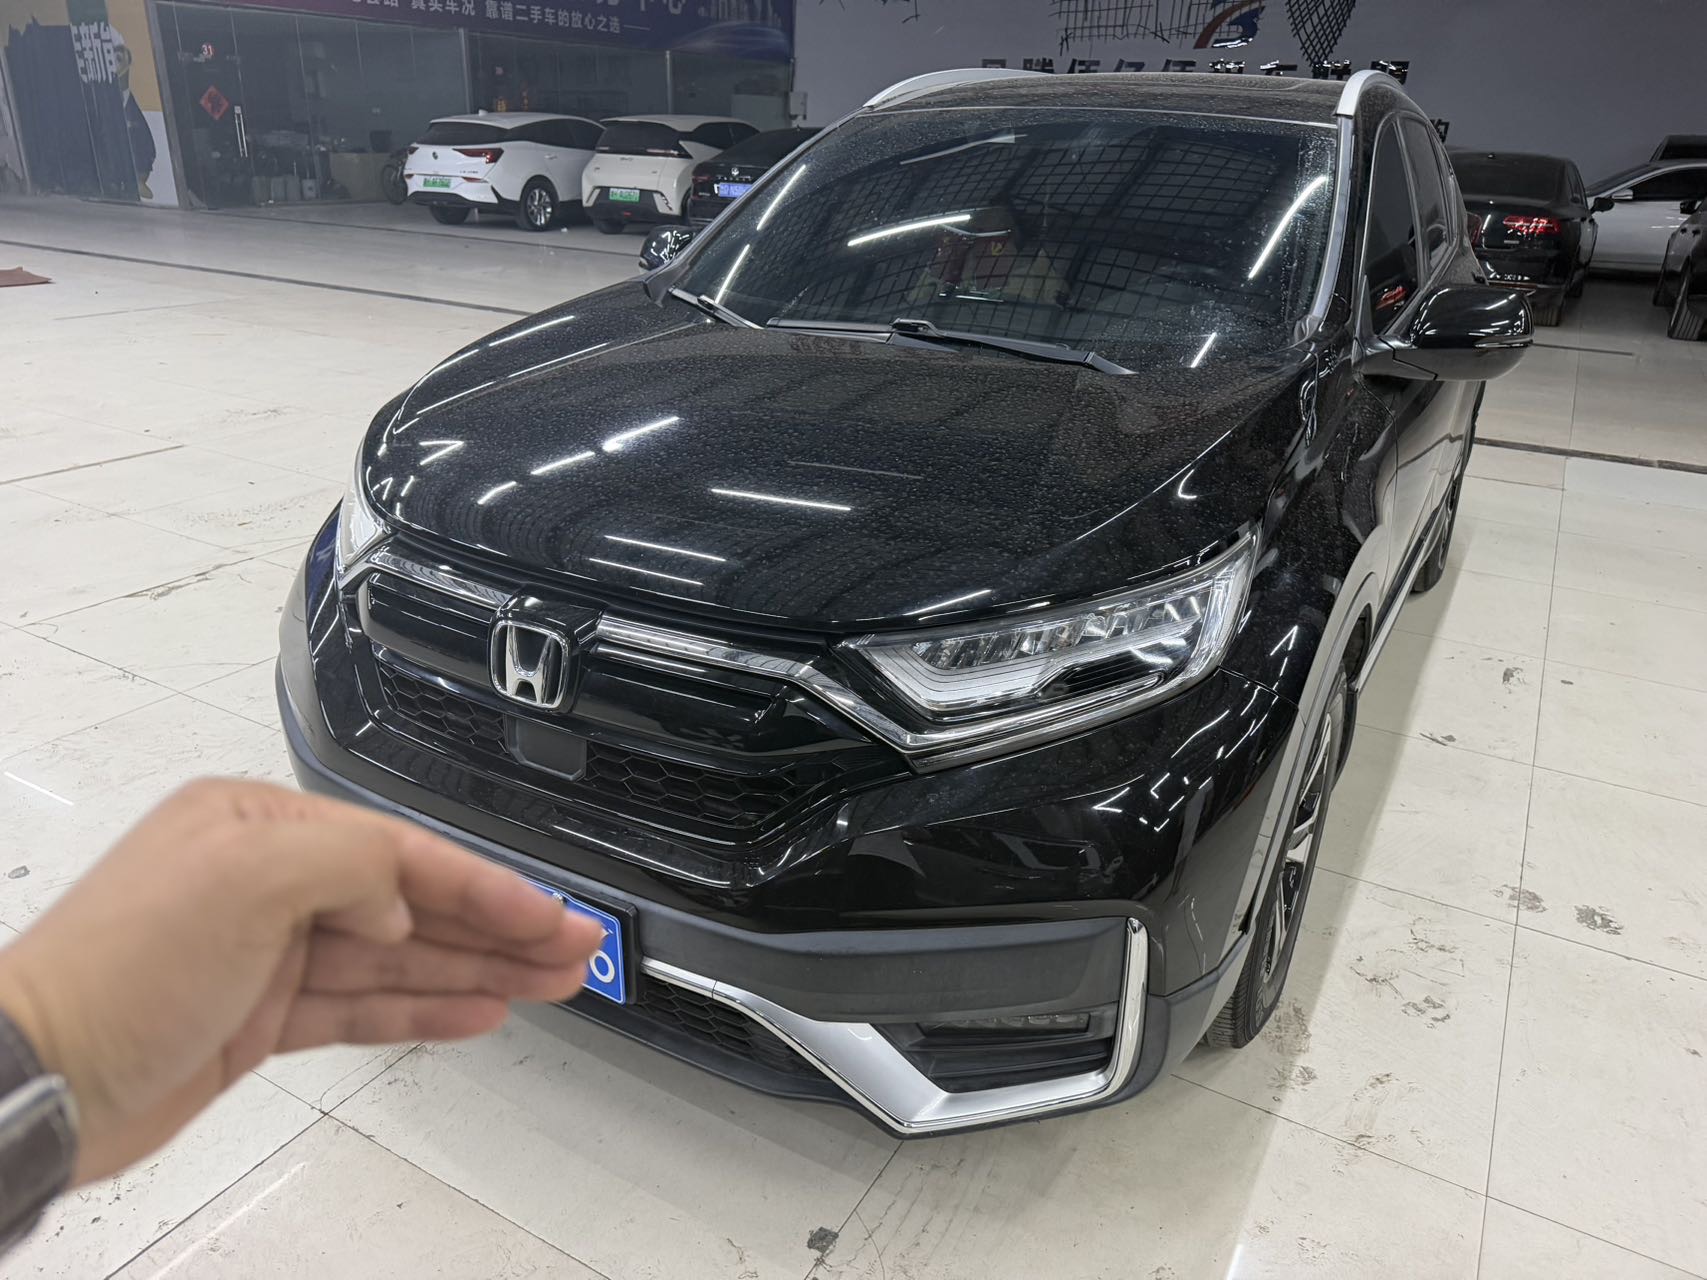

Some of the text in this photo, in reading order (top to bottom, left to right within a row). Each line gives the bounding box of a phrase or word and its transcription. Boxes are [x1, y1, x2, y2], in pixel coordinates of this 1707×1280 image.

[485, 0, 622, 34] 靠谱二手车的放心之选
[201, 44, 215, 56] 31
